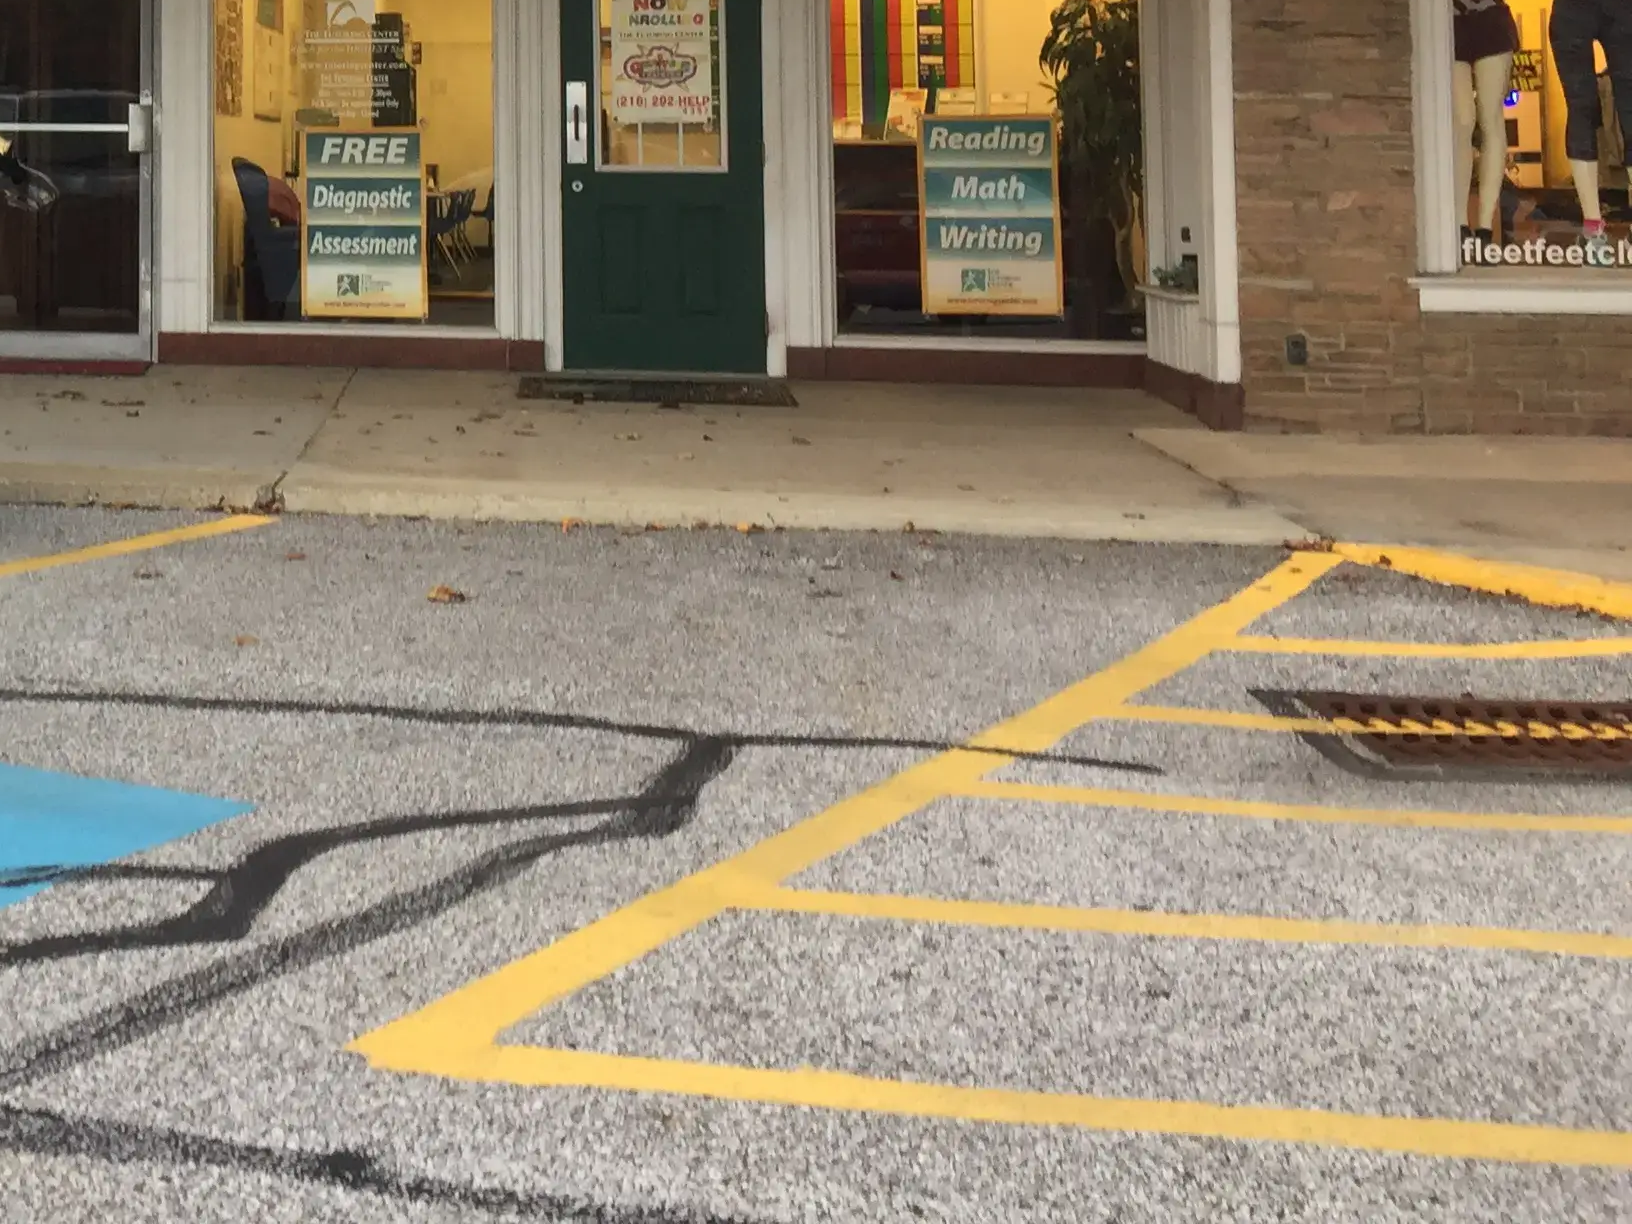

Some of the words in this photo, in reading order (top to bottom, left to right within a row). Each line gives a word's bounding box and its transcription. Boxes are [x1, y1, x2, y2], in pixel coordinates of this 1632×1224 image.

[320, 136, 409, 165] FREE
[929, 124, 1046, 157] Reading
[313, 183, 413, 214] Diagnostic
[951, 174, 1026, 201] Math
[310, 230, 418, 256] Assessment
[939, 223, 1043, 256] Writing
